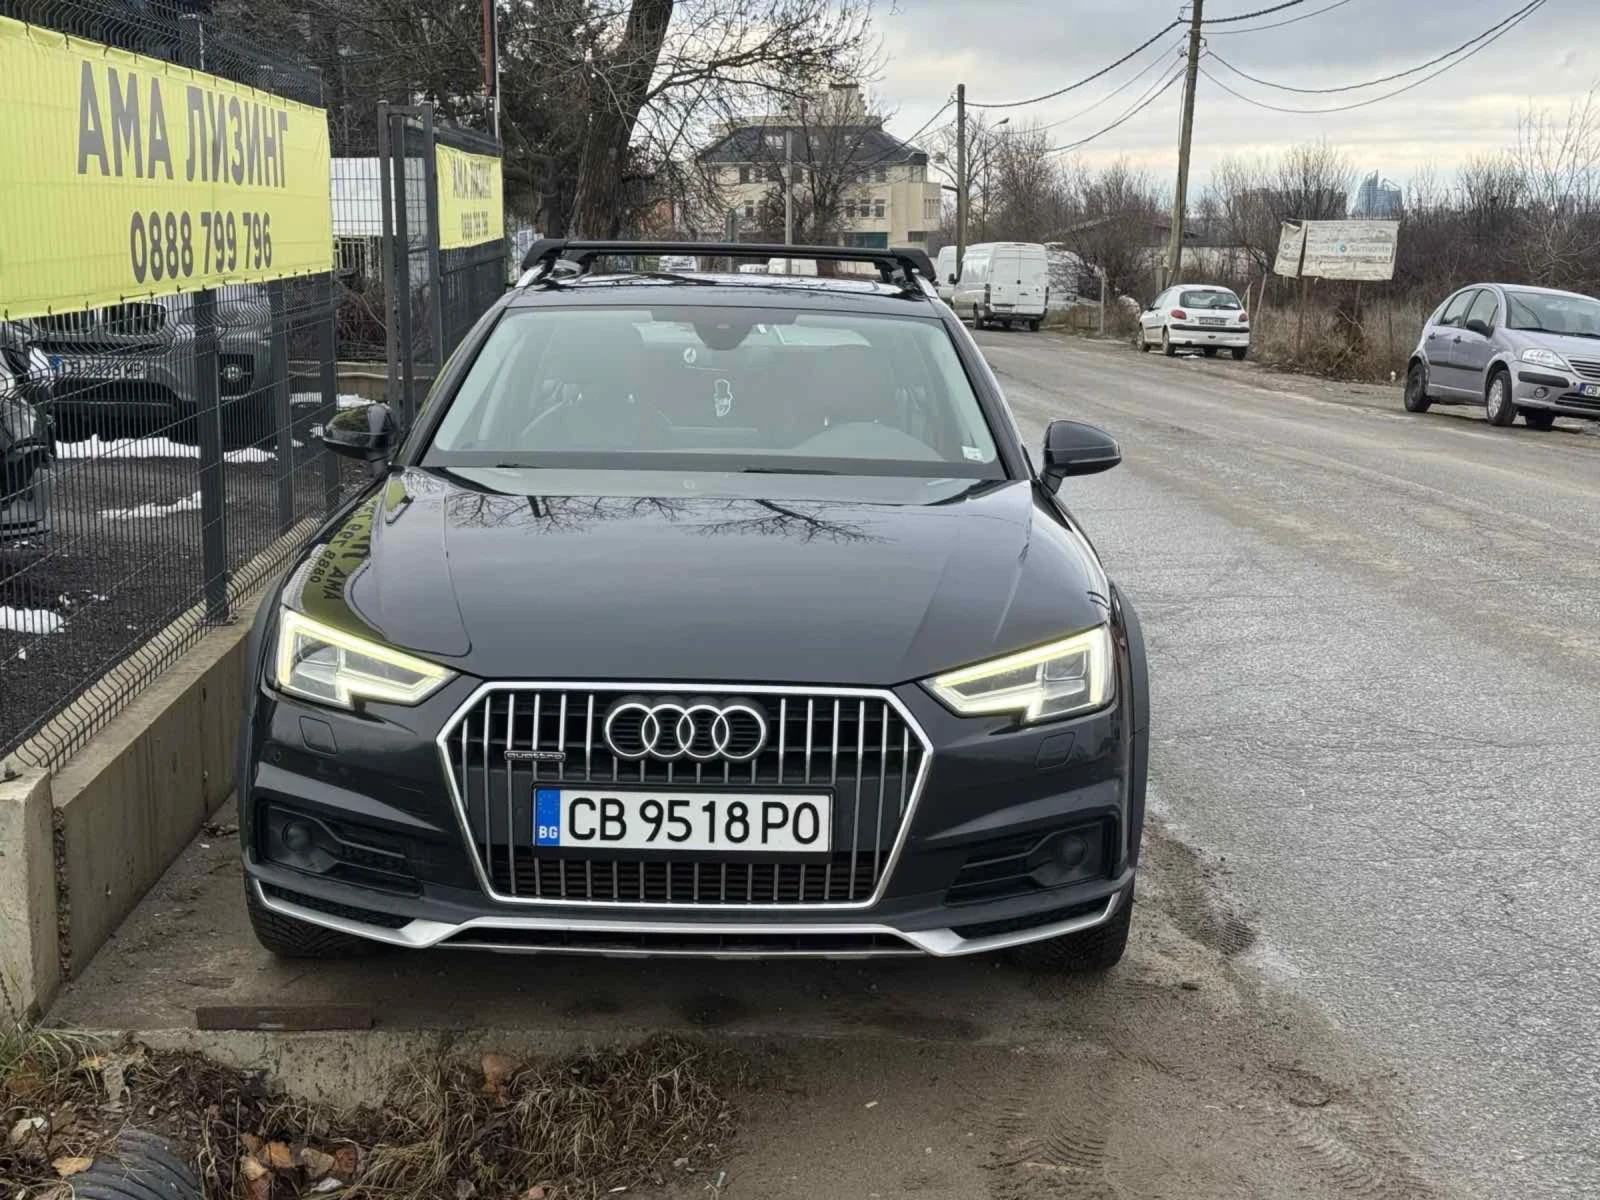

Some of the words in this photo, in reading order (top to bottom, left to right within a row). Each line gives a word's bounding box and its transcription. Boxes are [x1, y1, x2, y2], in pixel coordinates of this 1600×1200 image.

[78, 60, 174, 179] АМА
[186, 86, 288, 188] ЛИЗИНГ
[130, 211, 193, 284] 0888
[201, 211, 236, 275] 799
[243, 212, 272, 269] 796
[538, 827, 558, 839] BG
[568, 797, 627, 841] CB
[639, 799, 750, 843] 9518
